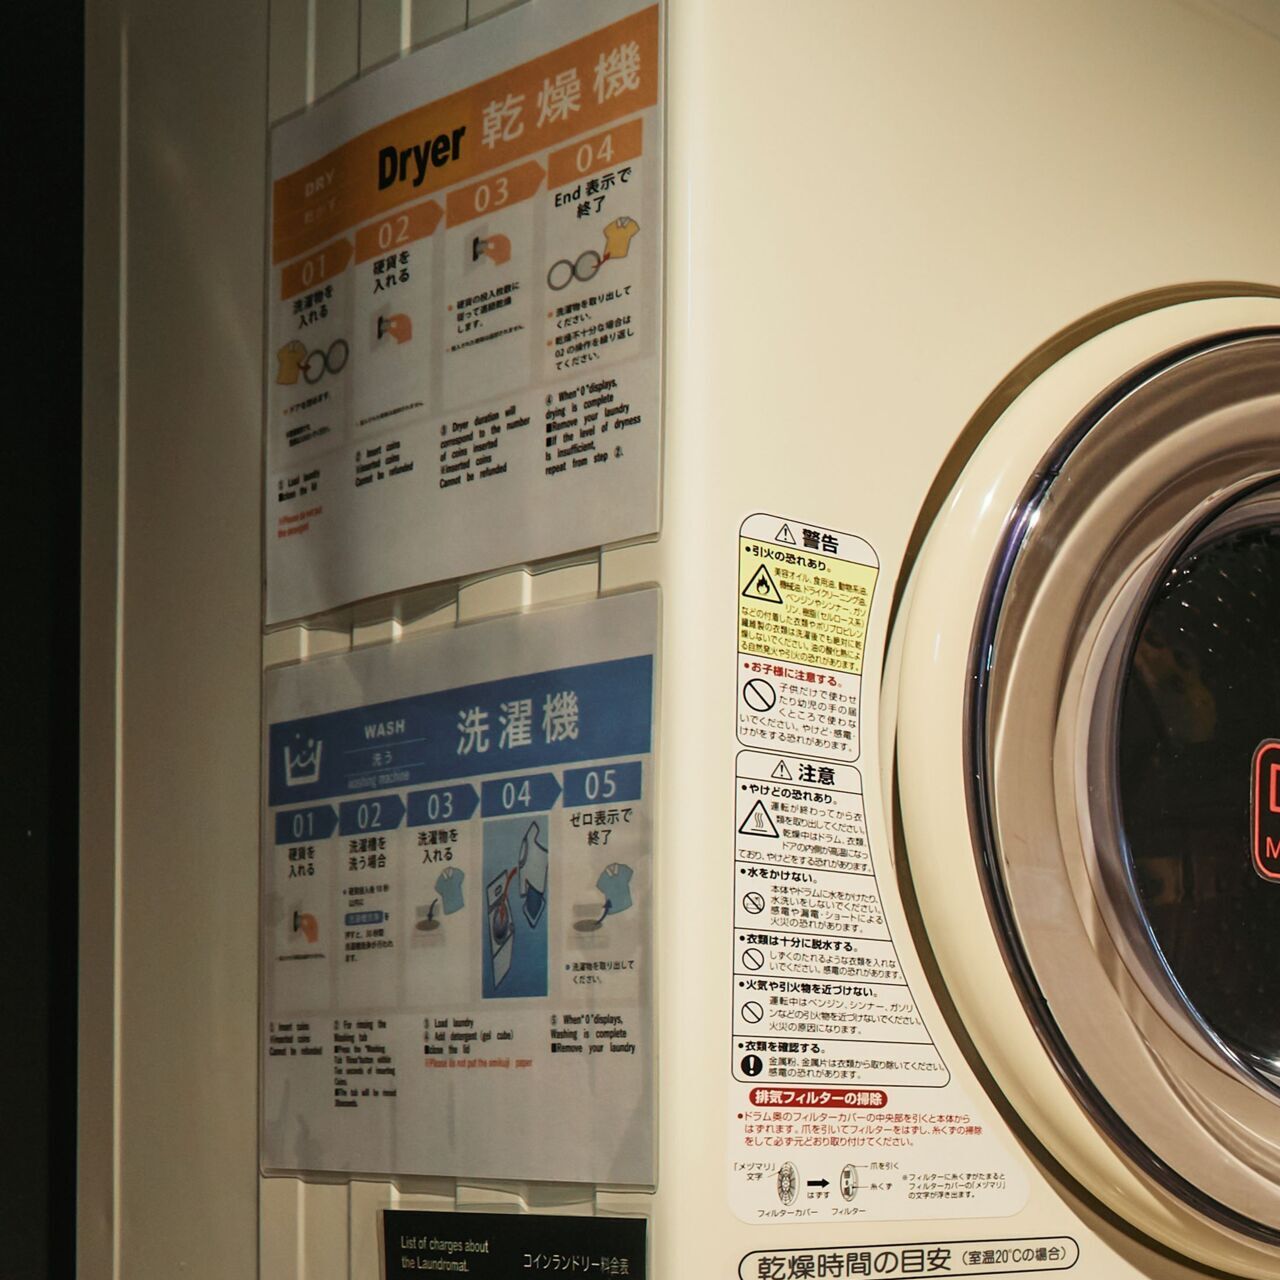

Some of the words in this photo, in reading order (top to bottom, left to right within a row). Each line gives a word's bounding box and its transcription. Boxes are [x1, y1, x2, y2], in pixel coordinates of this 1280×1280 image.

[377, 124, 466, 191] Dryer
[481, 41, 641, 149] 乾燥機
[576, 134, 614, 173] 04
[474, 177, 508, 212] 03
[555, 186, 581, 208] End
[586, 167, 631, 195] 表示で
[576, 195, 605, 219] 終了
[379, 215, 409, 249] 02
[302, 255, 325, 286] 01
[374, 269, 409, 294] 入れる
[584, 393, 614, 409] complete
[584, 413, 598, 425] your
[605, 403, 629, 418] laundry
[802, 528, 839, 554] 警告
[752, 545, 832, 573] 引火の恐れあり。
[751, 662, 842, 688] お子様に注意する。
[365, 719, 405, 740] WASH
[456, 691, 579, 757] 洗濯機
[584, 767, 616, 799] 05
[799, 764, 835, 785] 注意
[428, 793, 453, 820] 03
[502, 780, 532, 810] 04
[749, 784, 837, 805] やけどの恐れあり。
[294, 812, 313, 838] 01
[358, 803, 381, 829] 02
[569, 808, 633, 827] ゼロ表示で
[588, 828, 612, 846] 終了
[422, 847, 453, 864] 入れる
[747, 867, 818, 884] 水をかけない。
[746, 934, 858, 953] 衣類は十分に脱水する。
[596, 1029, 627, 1040] complete
[589, 1045, 603, 1054] your
[610, 1043, 635, 1054] laundry
[746, 1041, 826, 1054] 衣類を確認する。
[755, 1090, 882, 1106] 排気フィルターの掃除
[831, 1207, 866, 1216] フィルター
[401, 1236, 416, 1249] List
[418, 1236, 427, 1249] of
[430, 1238, 462, 1254] charges
[465, 1239, 489, 1253] about
